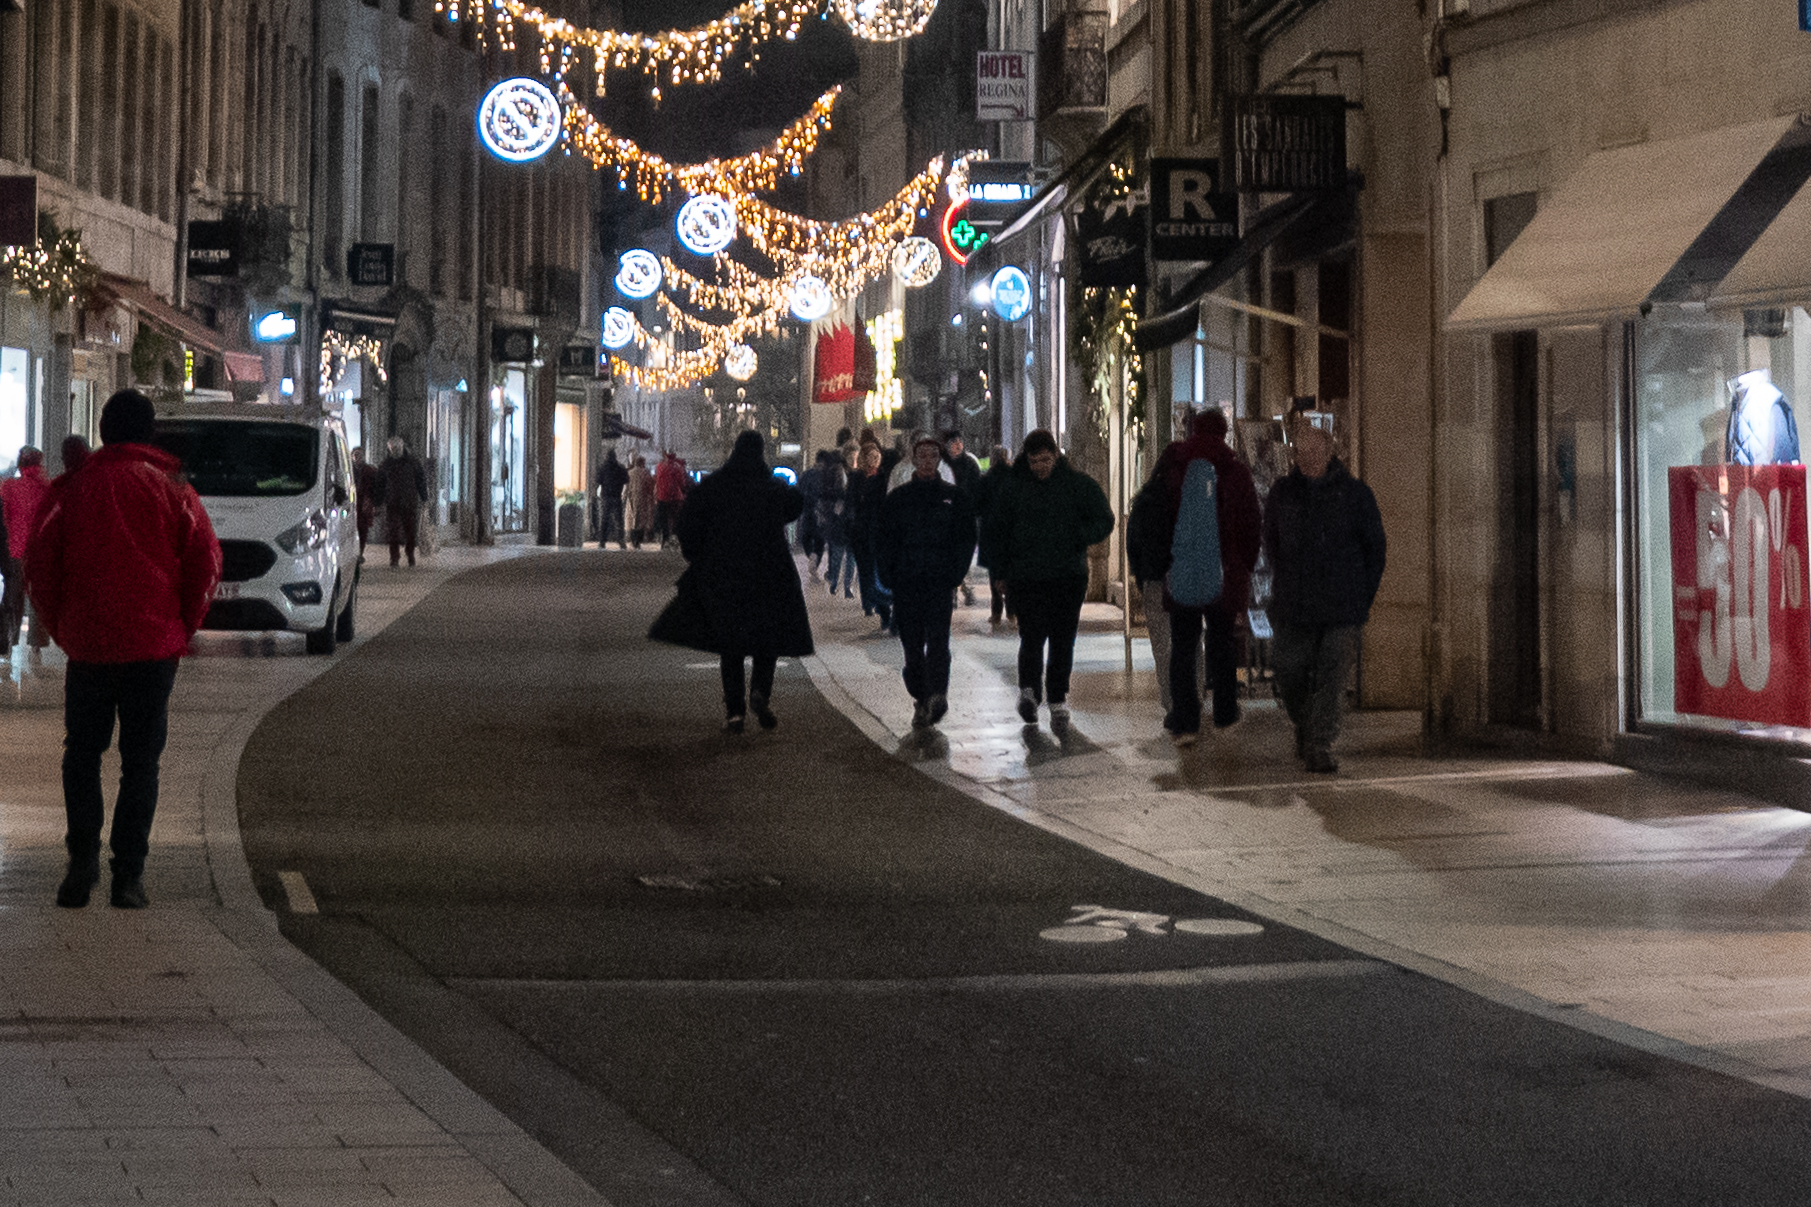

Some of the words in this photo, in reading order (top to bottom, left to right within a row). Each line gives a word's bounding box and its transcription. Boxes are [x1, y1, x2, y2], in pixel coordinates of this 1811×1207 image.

[979, 54, 1026, 79] HOTEL
[979, 83, 1026, 98] REGINA
[1168, 168, 1217, 221] R
[1154, 222, 1235, 238] CENTER
